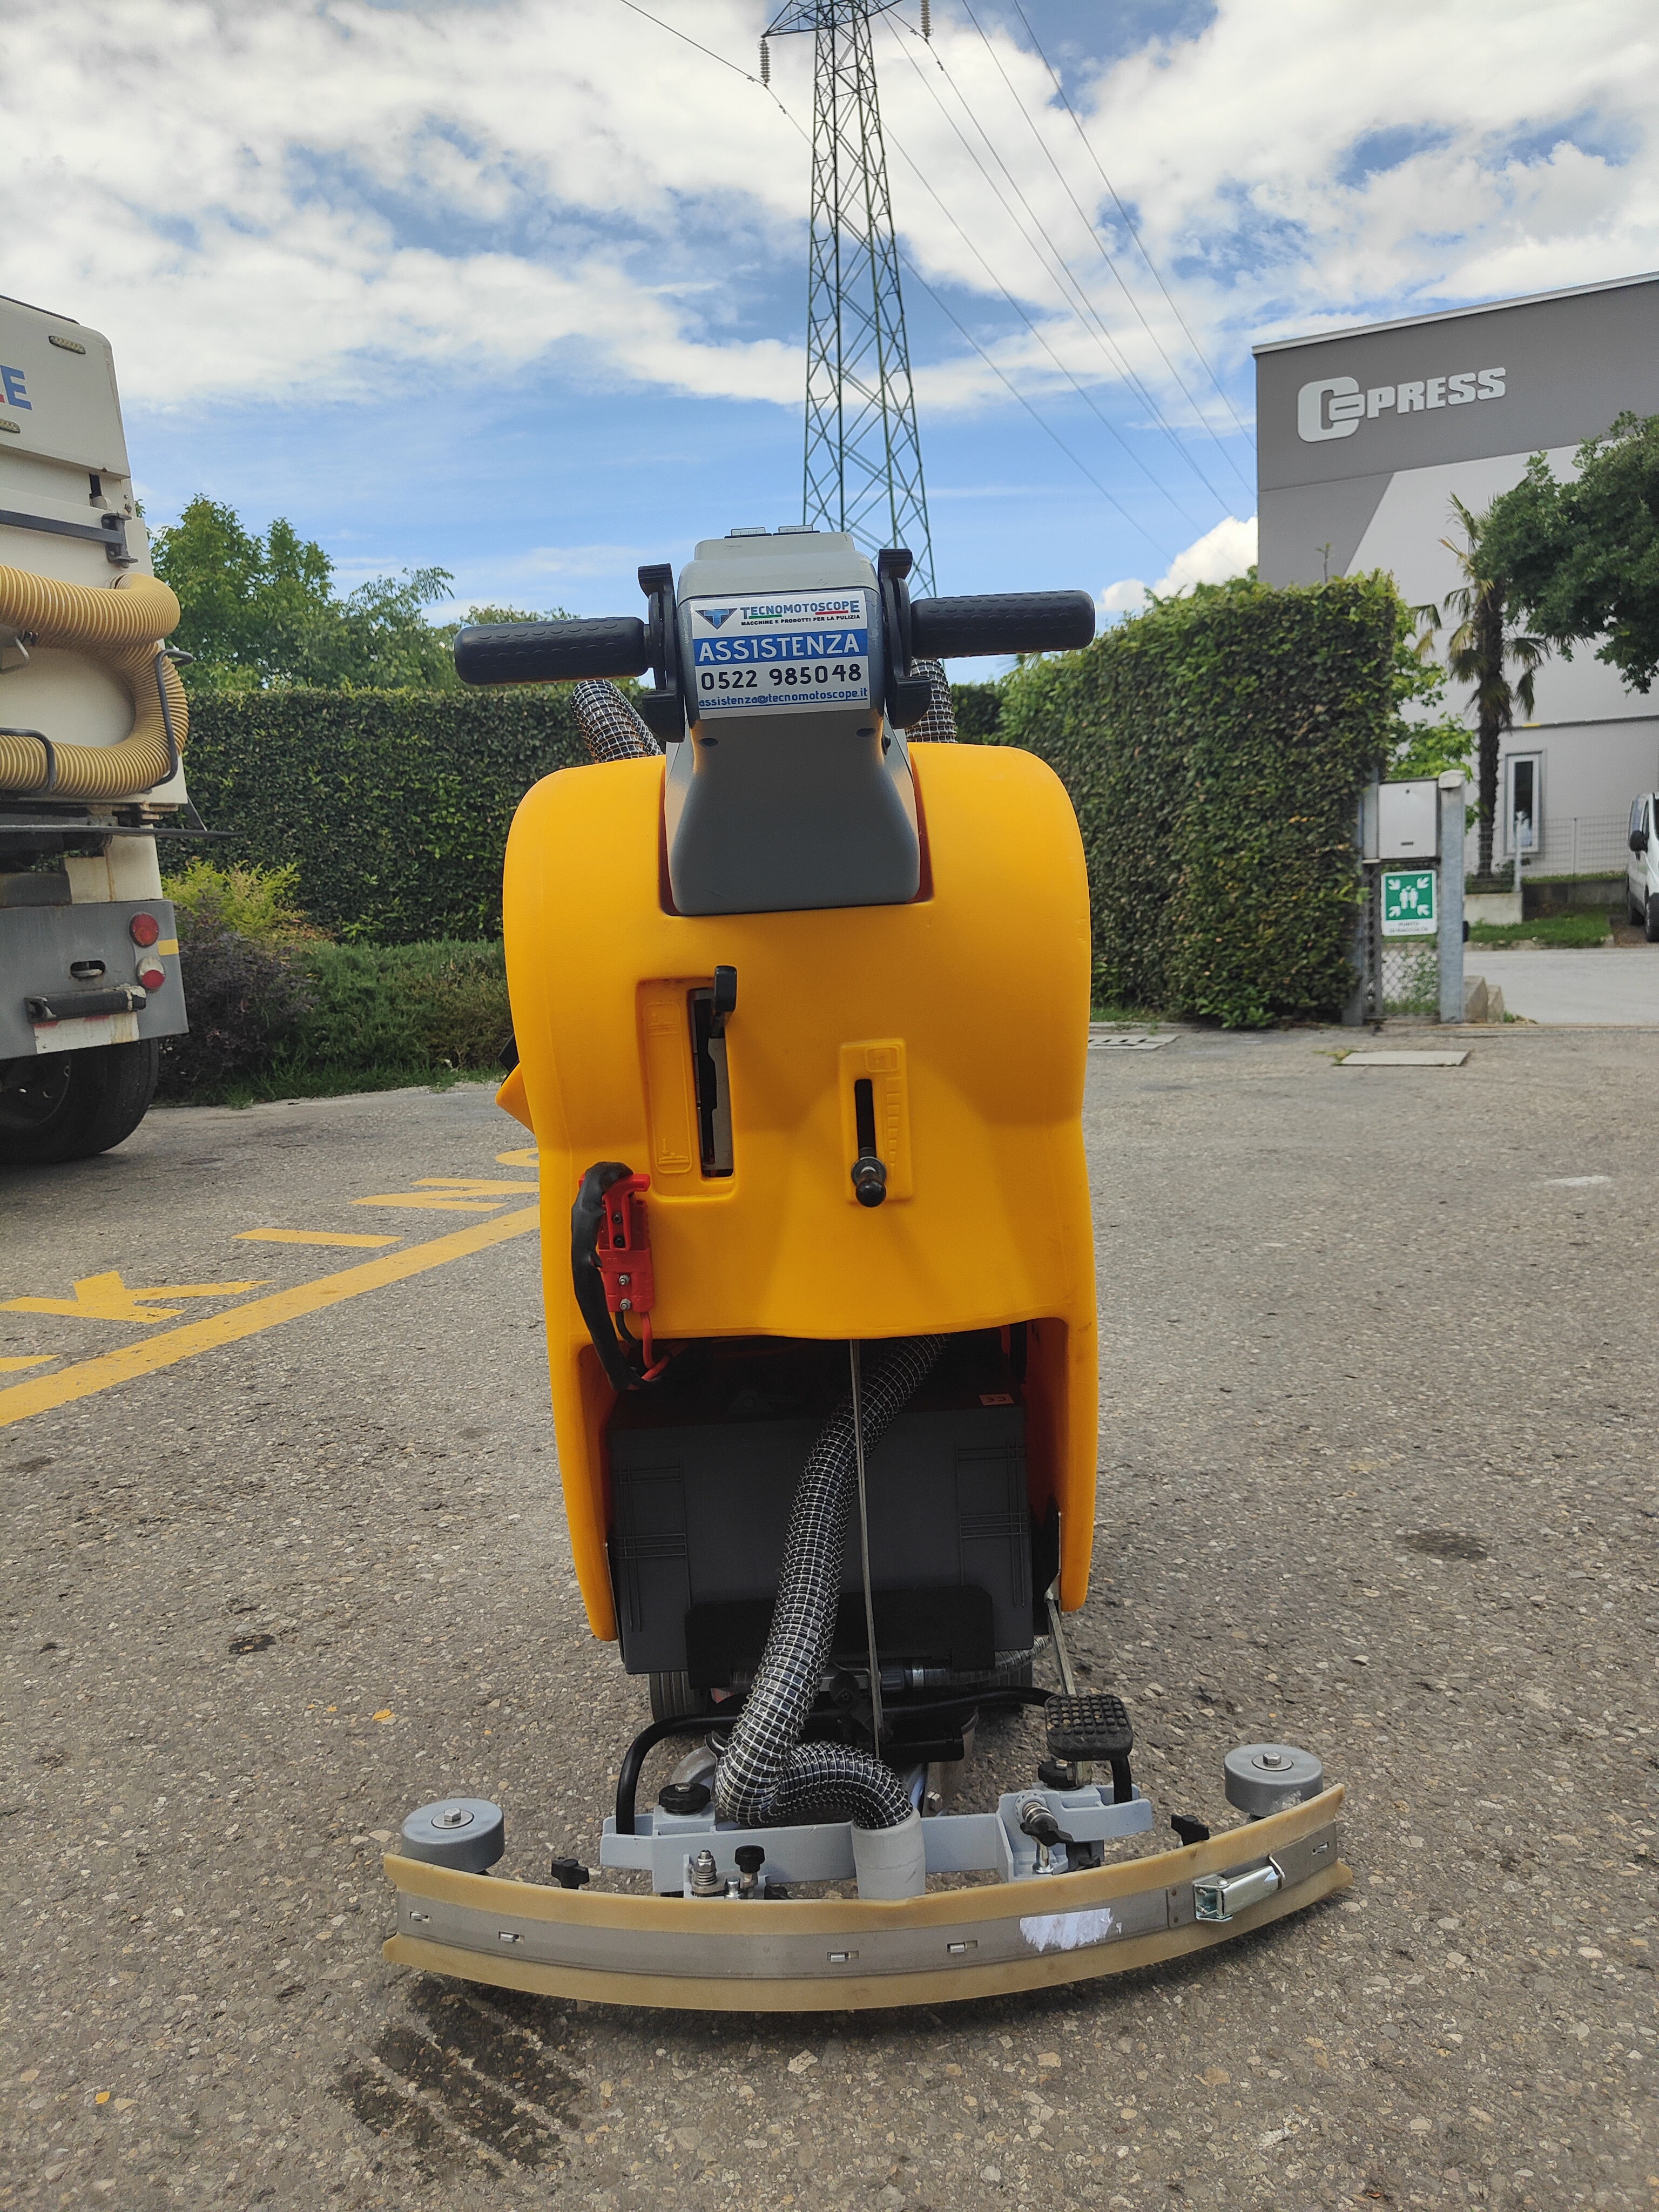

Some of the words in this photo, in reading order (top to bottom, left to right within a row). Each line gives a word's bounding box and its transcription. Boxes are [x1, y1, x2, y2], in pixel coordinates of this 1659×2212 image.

[0, 365, 33, 410] E
[740, 601, 860, 619] TECNOMOTOSCOPE
[699, 633, 860, 662] ASSISTENZA
[701, 670, 758, 690] 0522
[769, 664, 861, 686] 985048
[699, 687, 868, 707] assistenza@tecnomotoscope.it
